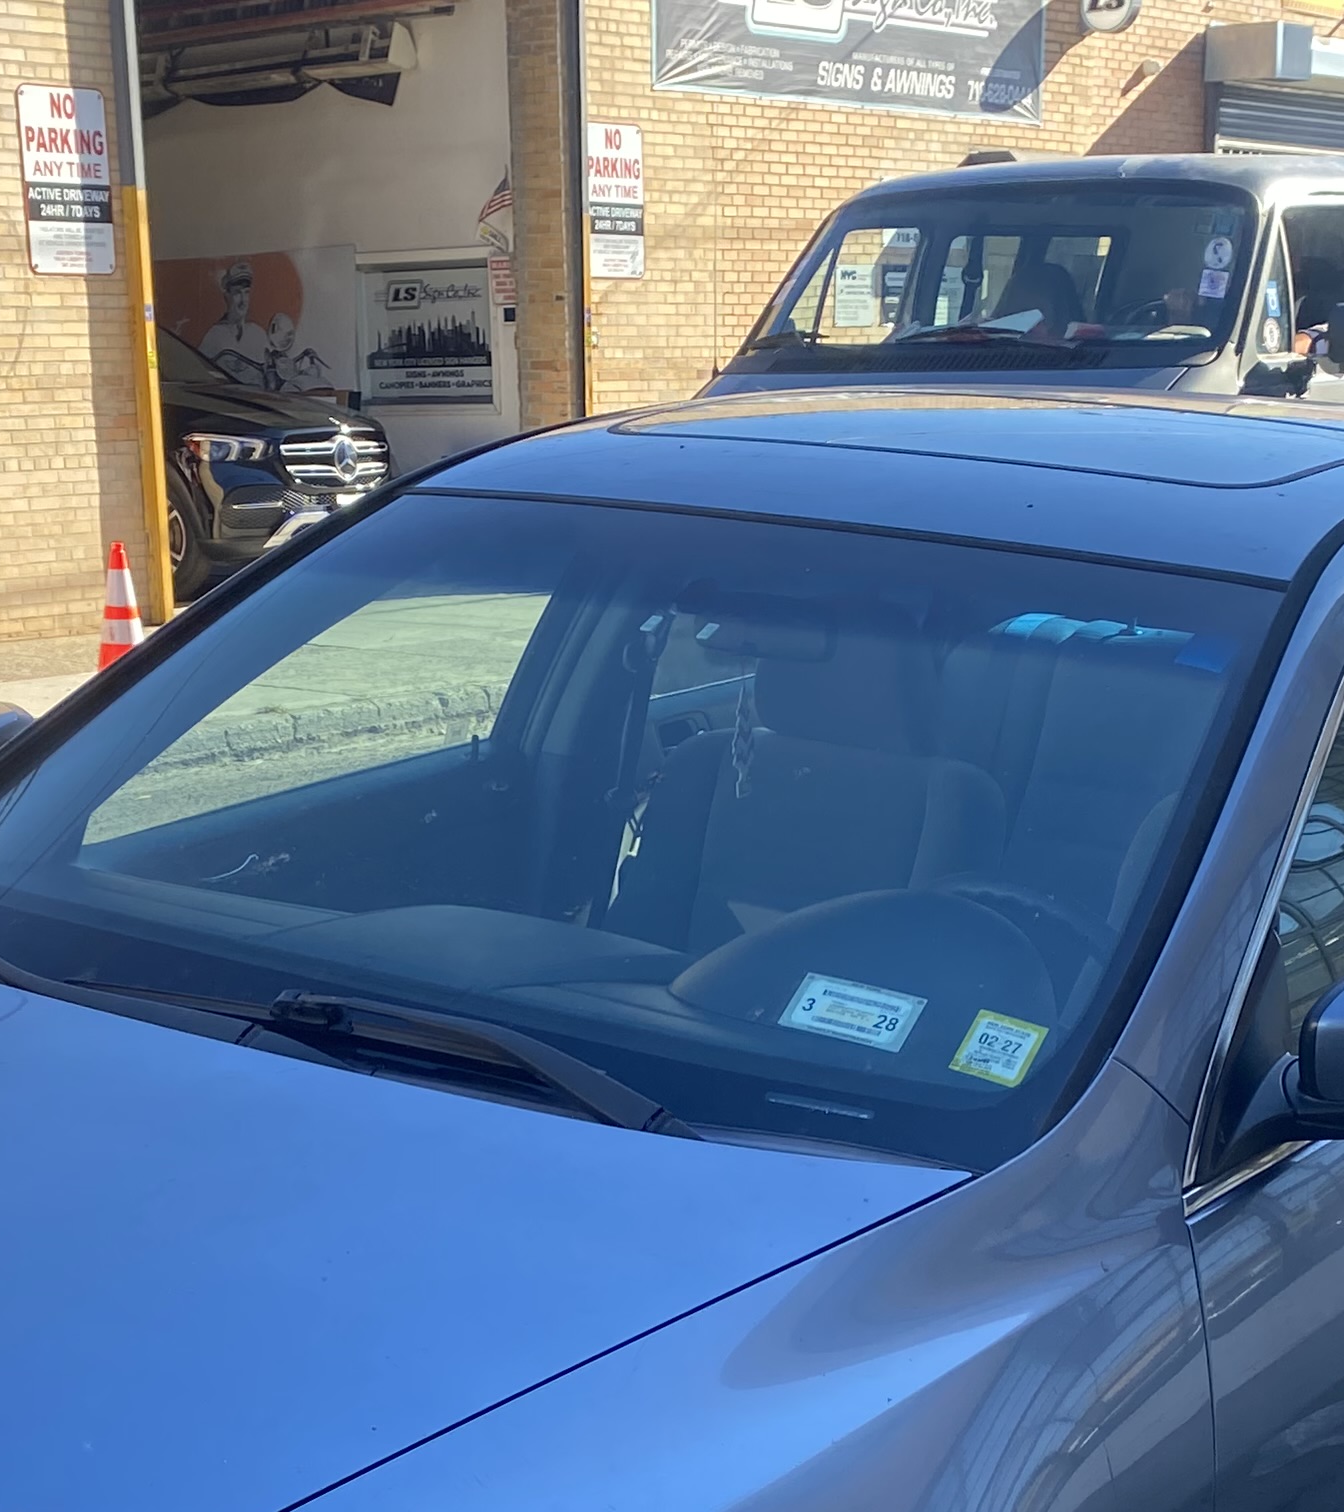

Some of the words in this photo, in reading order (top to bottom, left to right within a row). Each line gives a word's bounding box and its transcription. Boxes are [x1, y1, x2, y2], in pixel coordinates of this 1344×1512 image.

[740, 45, 780, 57] FABRICATION
[748, 57, 793, 71] INSTALLATIONS
[817, 61, 864, 90] SIGNS
[870, 67, 883, 91] &
[883, 69, 956, 99] AWNINGS
[49, 92, 75, 119] NO
[25, 126, 104, 155] PARKING
[604, 128, 622, 150] NO
[33, 160, 63, 177] ANY
[66, 161, 102, 178] TIME
[587, 155, 640, 180] PARKING
[28, 187, 62, 200] ACTIVE
[63, 189, 110, 202] DRIVEWAY
[591, 183, 612, 198] ANY
[614, 184, 639, 199] TIME
[40, 204, 65, 216] 24HR
[71, 205, 101, 218] 7DAYS
[611, 207, 643, 218] DRIVEWAY
[392, 287, 417, 301] LS
[379, 381, 414, 389] CANOPIES
[419, 381, 451, 389] BANNERS
[456, 380, 492, 388] GRAPHICS
[801, 998, 816, 1012] 3
[872, 1014, 899, 1032] 28
